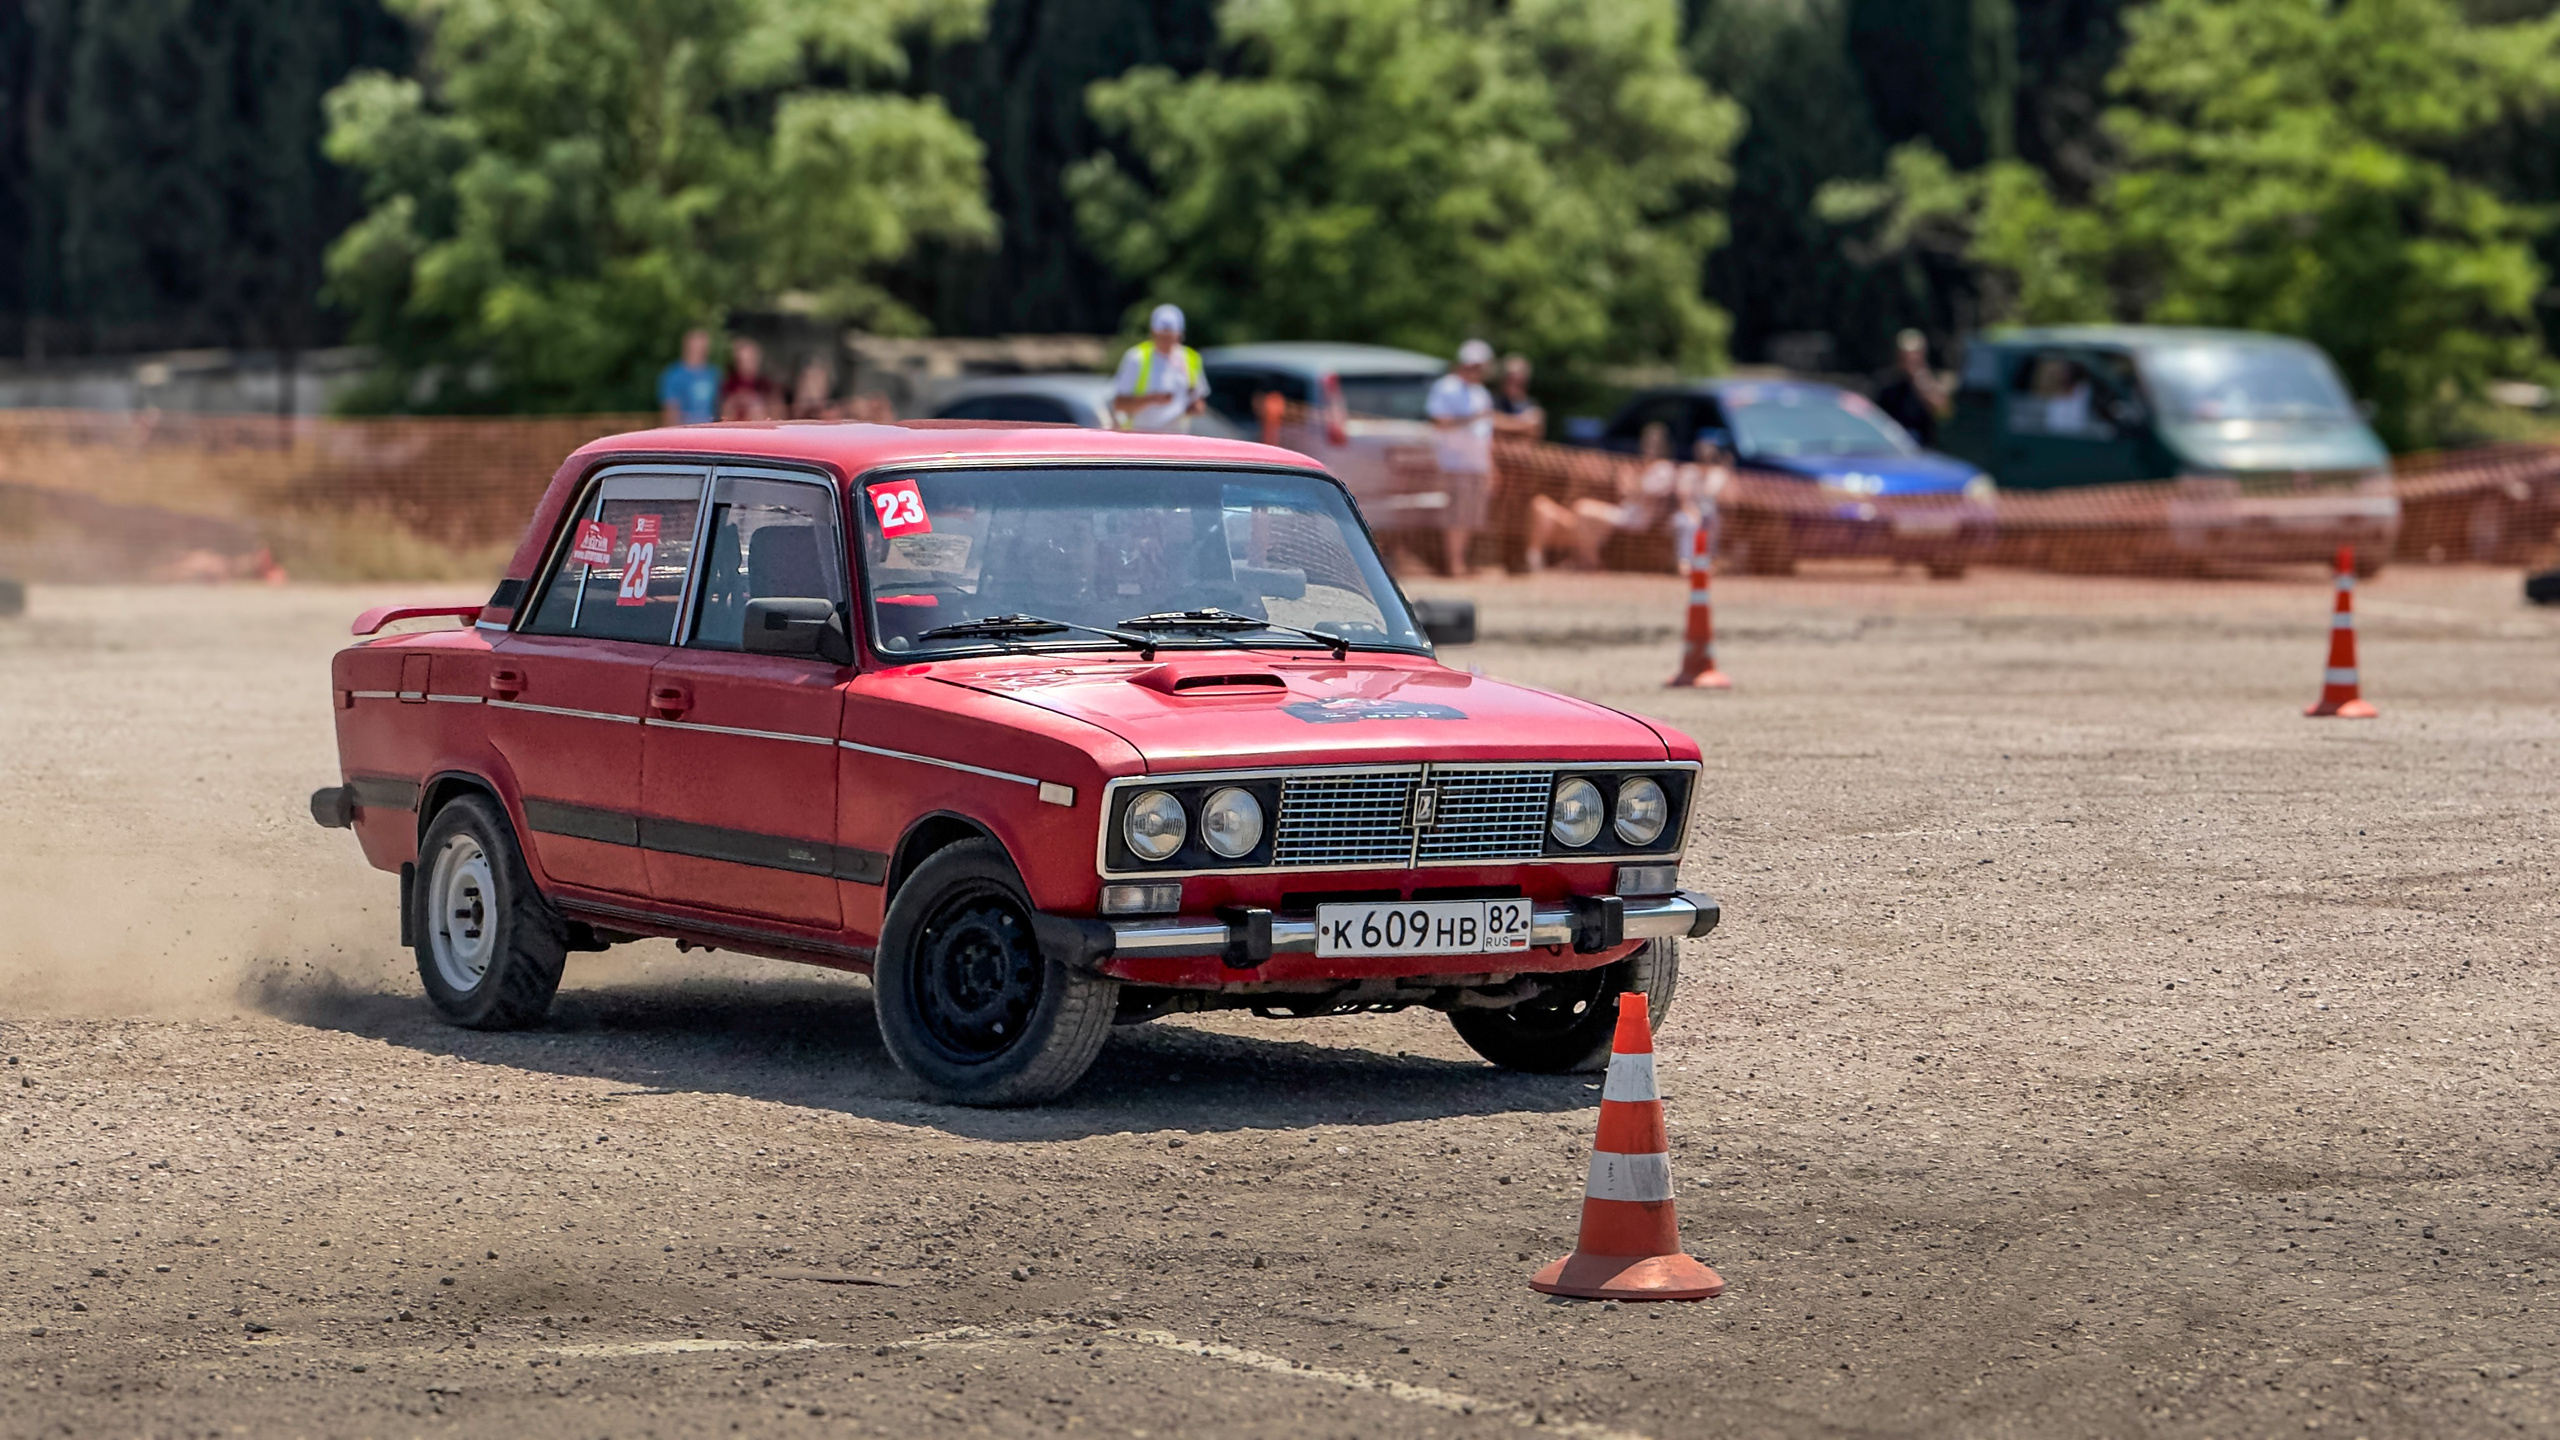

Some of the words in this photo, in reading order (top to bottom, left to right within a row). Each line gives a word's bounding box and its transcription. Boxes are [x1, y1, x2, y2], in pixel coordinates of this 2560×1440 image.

[877, 490, 924, 528] 23
[619, 542, 654, 599] 23
[1489, 904, 1520, 934] 82
[1486, 936, 1509, 948] RUS
